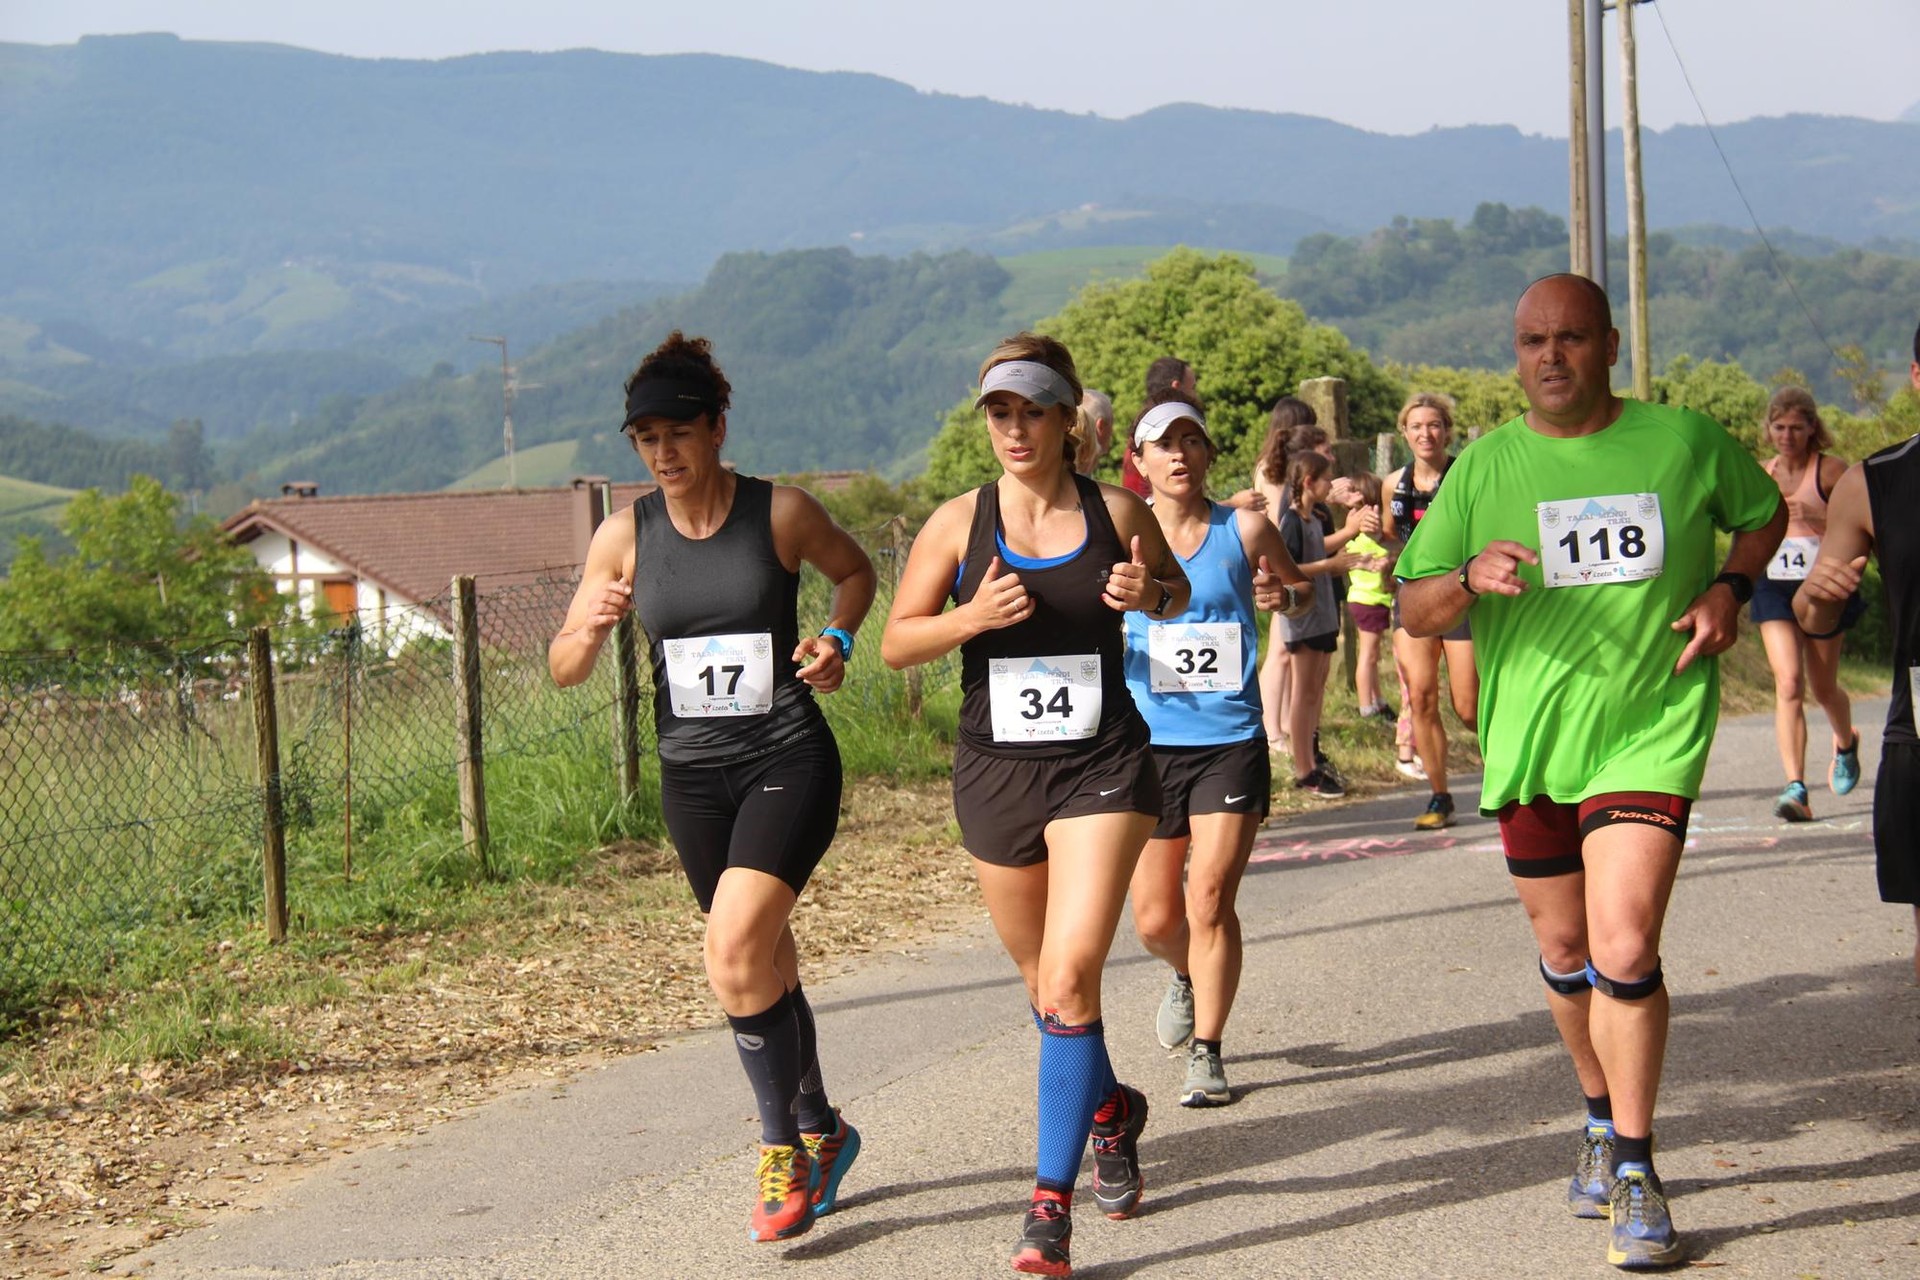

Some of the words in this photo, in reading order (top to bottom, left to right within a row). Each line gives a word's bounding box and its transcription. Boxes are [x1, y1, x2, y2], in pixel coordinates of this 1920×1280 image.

[1559, 525, 1646, 564] 118
[1779, 552, 1806, 568] 14
[1175, 648, 1218, 674] 32
[698, 665, 745, 696] 17
[1020, 687, 1073, 720] 34
